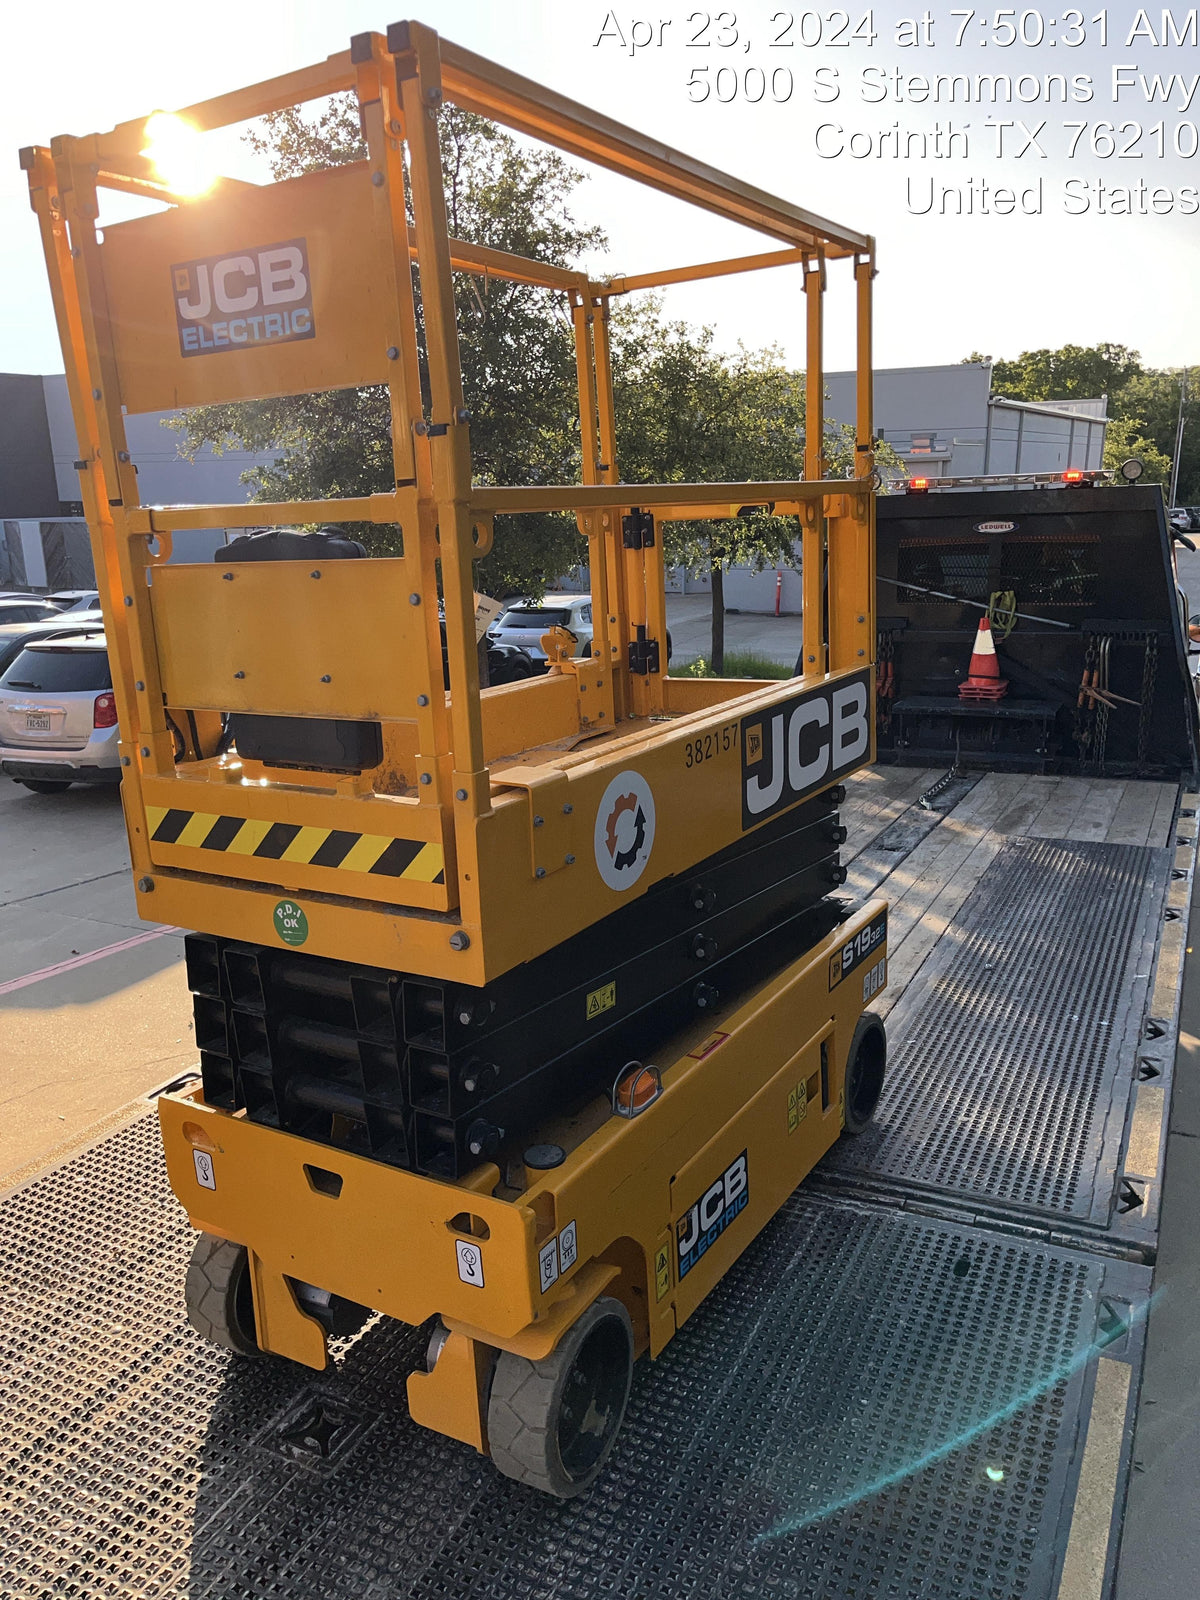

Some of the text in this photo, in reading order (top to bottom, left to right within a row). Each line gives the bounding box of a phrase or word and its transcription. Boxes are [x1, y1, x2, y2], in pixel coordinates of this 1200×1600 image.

[177, 246, 307, 320] JCB
[181, 307, 312, 351] ELECTRIC
[685, 722, 739, 768] 382157
[746, 681, 868, 815] JCB
[276, 904, 302, 919] P.D.I
[283, 918, 299, 928] OK
[679, 1156, 747, 1256] JCB
[680, 1190, 747, 1279] ELECTRIC
